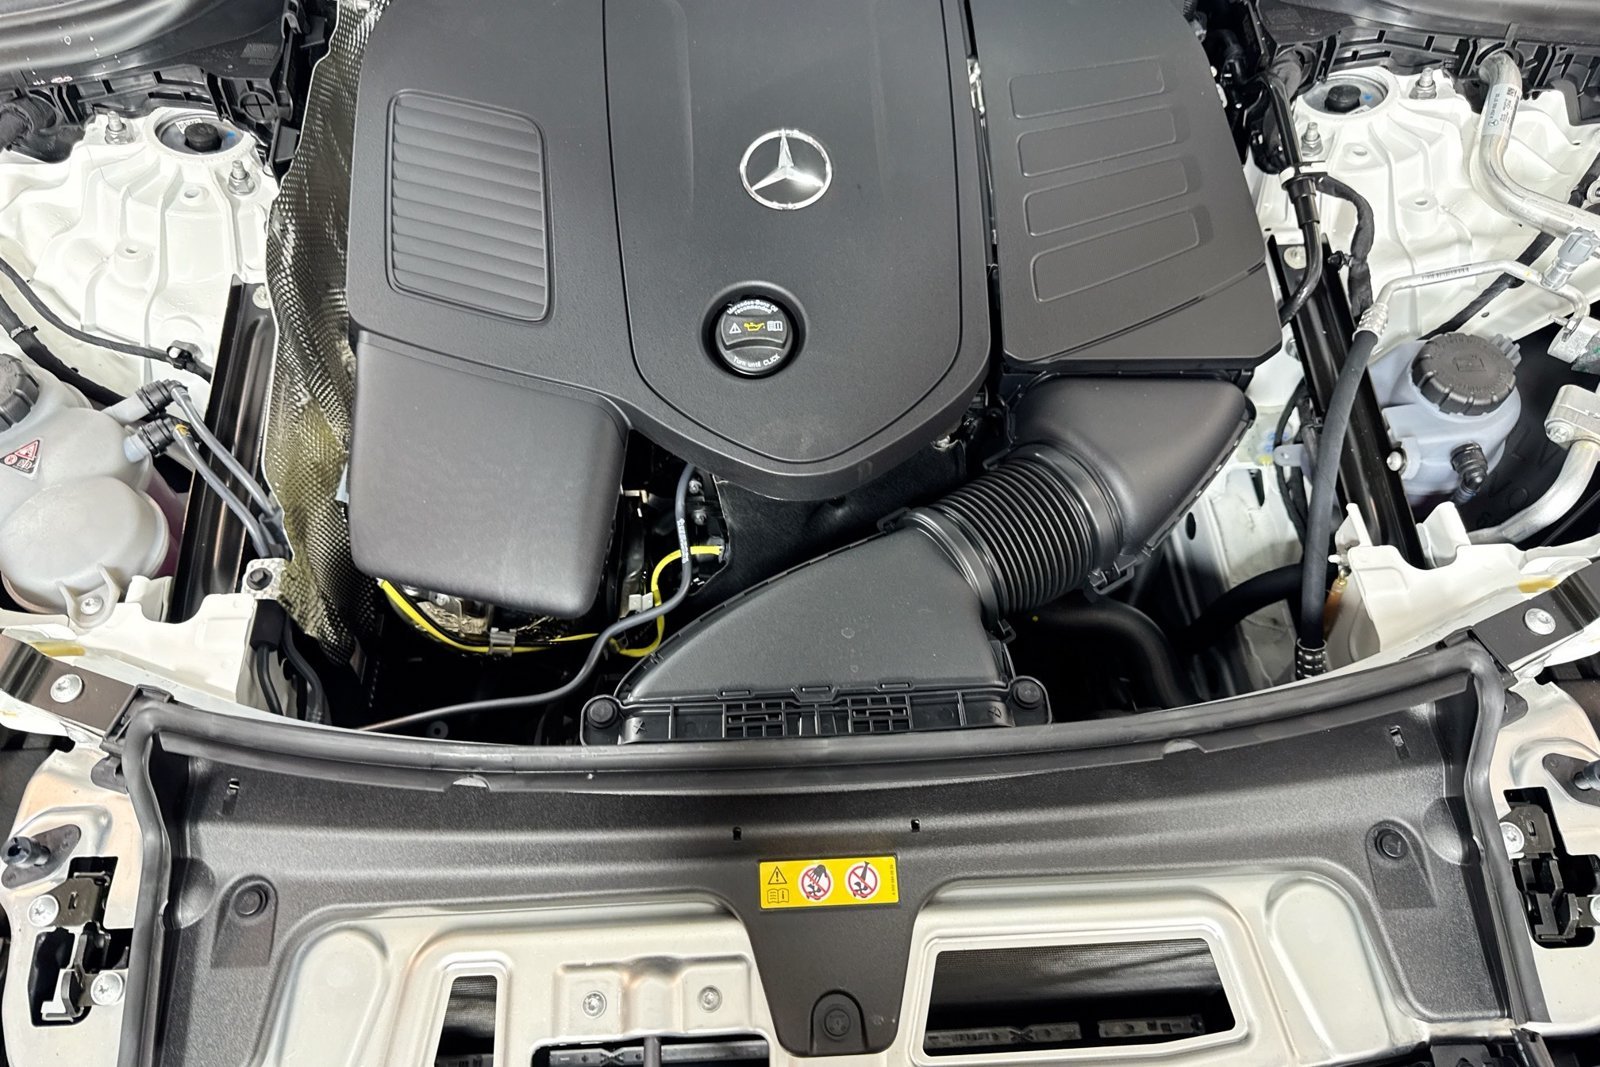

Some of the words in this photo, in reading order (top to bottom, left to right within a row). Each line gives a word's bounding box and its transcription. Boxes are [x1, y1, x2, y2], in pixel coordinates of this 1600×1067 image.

[726, 299, 770, 314] Mercedes-Benz
[734, 305, 772, 315] recommended
[733, 356, 746, 366] Turn
[763, 353, 780, 366] CLICK
